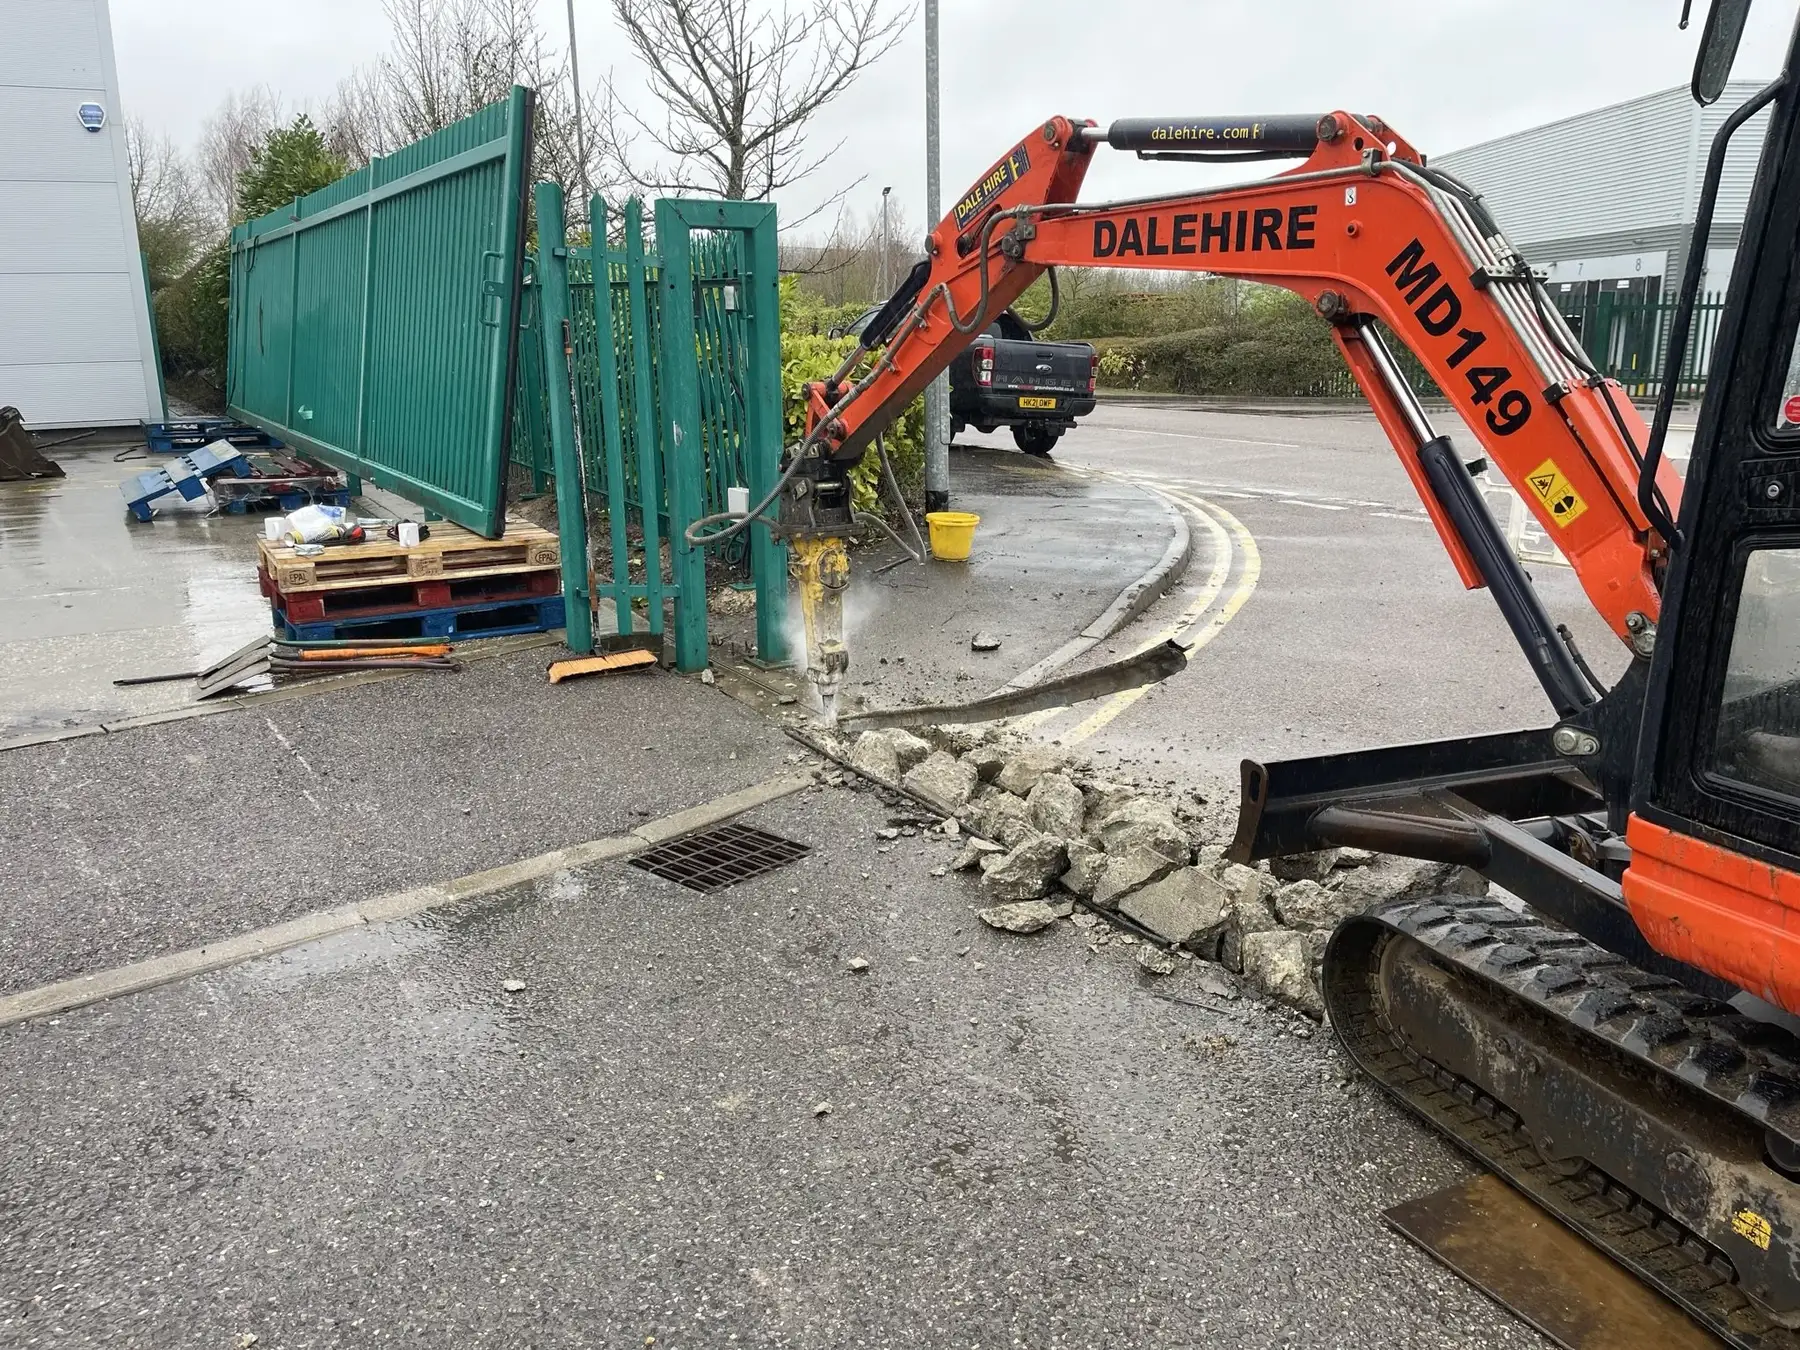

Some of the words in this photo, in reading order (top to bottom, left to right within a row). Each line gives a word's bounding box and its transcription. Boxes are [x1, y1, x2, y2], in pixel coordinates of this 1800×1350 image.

[1151, 125, 1250, 140] dalehire.com
[957, 187, 983, 219] DALE
[982, 165, 1008, 196] HIRE
[1093, 204, 1319, 258] DALEHIRE
[1578, 262, 1584, 276] 7
[1635, 257, 1642, 272] 8
[1384, 237, 1532, 436] MD149
[996, 374, 1087, 389] RANGER
[1023, 398, 1038, 407] HK21
[538, 552, 554, 561] EPAL
[289, 573, 307, 583] EPAL
